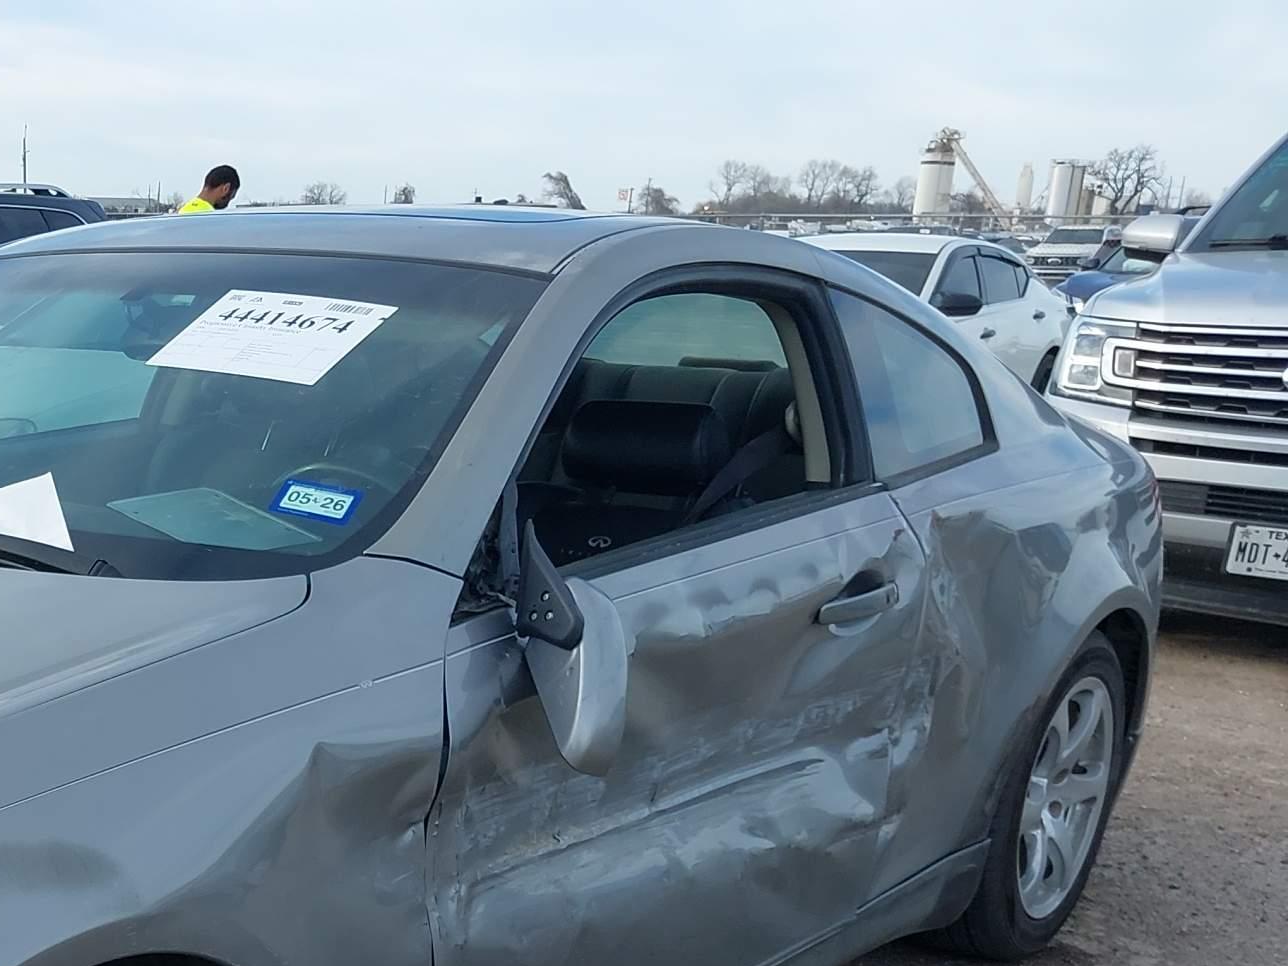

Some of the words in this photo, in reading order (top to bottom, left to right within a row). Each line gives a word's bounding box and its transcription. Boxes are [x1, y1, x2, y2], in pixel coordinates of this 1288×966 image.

[218, 308, 355, 333] 44414674
[288, 491, 313, 504] 05
[320, 497, 346, 511] 26
[1236, 542, 1272, 565] MDT
